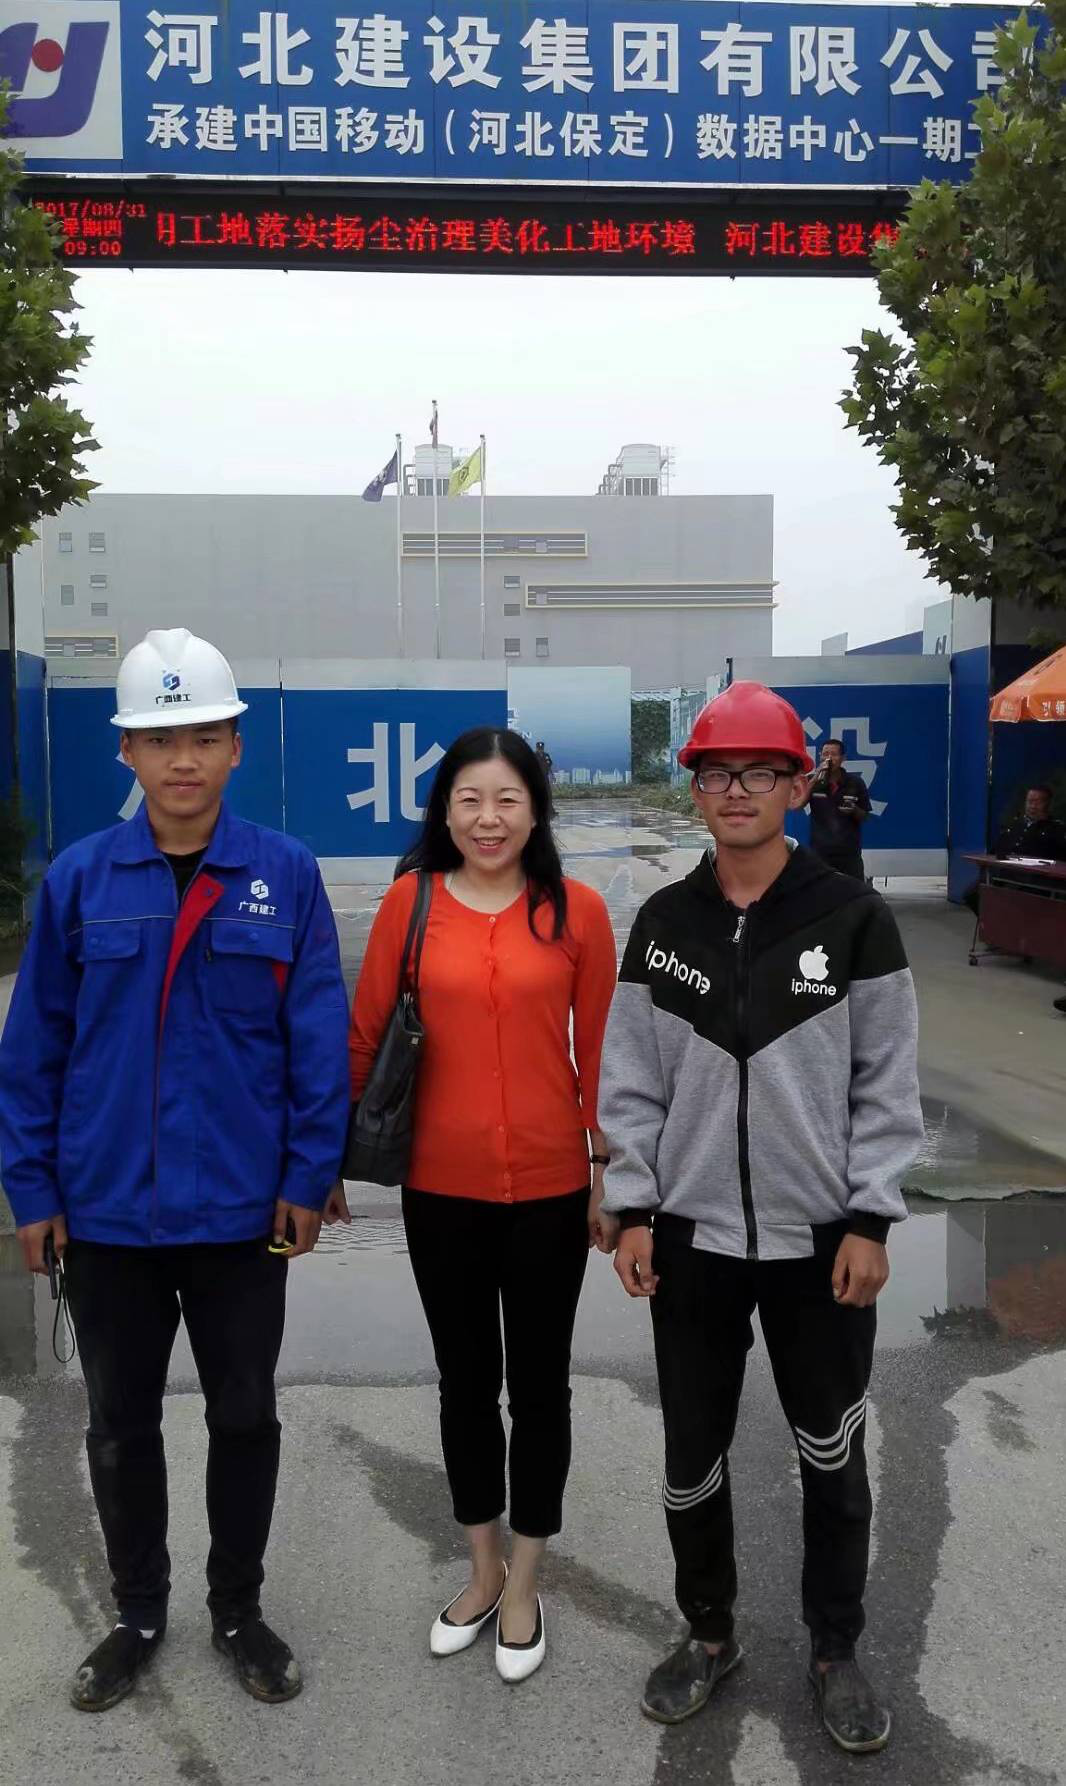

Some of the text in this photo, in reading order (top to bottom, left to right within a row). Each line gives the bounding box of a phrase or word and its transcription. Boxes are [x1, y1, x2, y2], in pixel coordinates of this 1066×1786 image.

[144, 9, 1034, 99] 河北建设集团有限公司
[63, 240, 122, 256] 09:00
[155, 693, 192, 705] 广西建工
[346, 722, 446, 823] 北
[238, 900, 277, 916] 广西建工
[645, 940, 837, 996] iphone iphone
